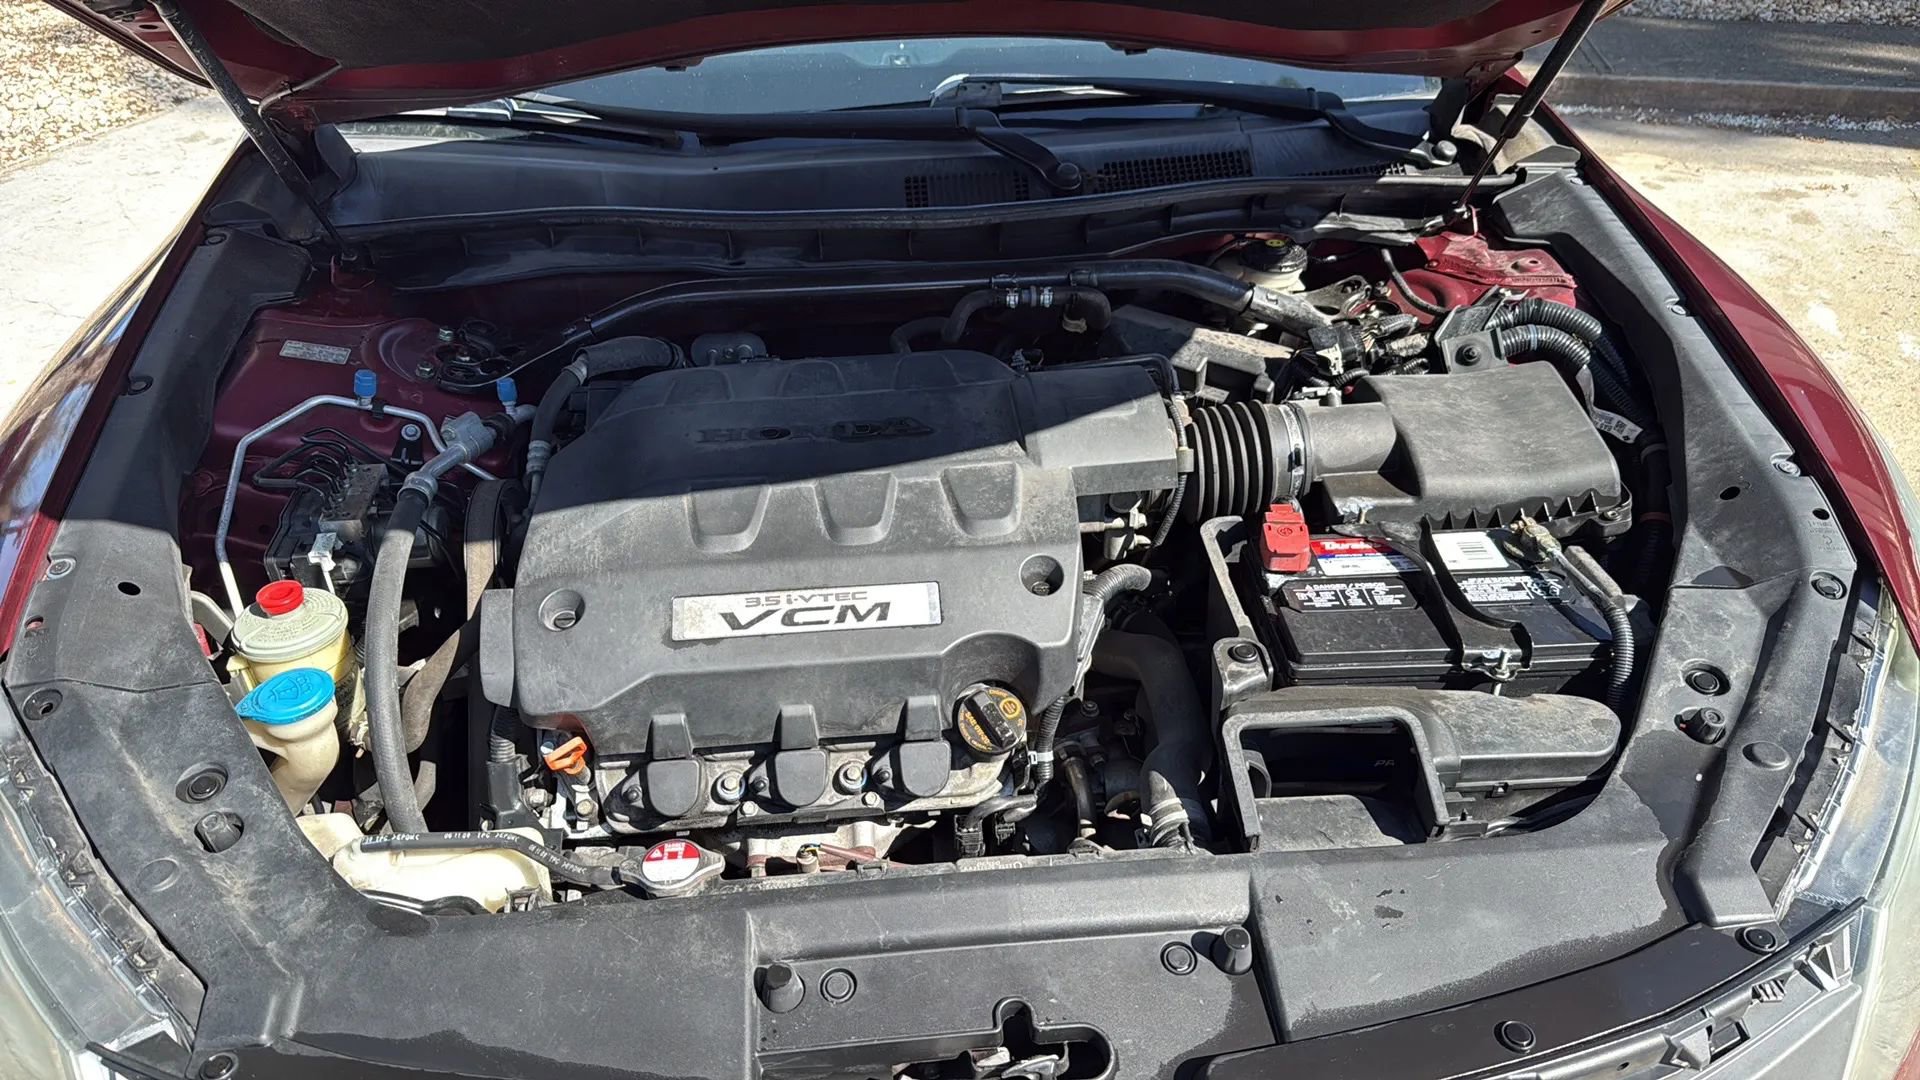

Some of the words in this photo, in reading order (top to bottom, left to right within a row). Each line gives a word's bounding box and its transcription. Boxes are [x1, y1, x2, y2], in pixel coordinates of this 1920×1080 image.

[745, 595, 780, 608] 3.5
[785, 591, 868, 605] i-VTEC
[720, 601, 891, 631] VCM
